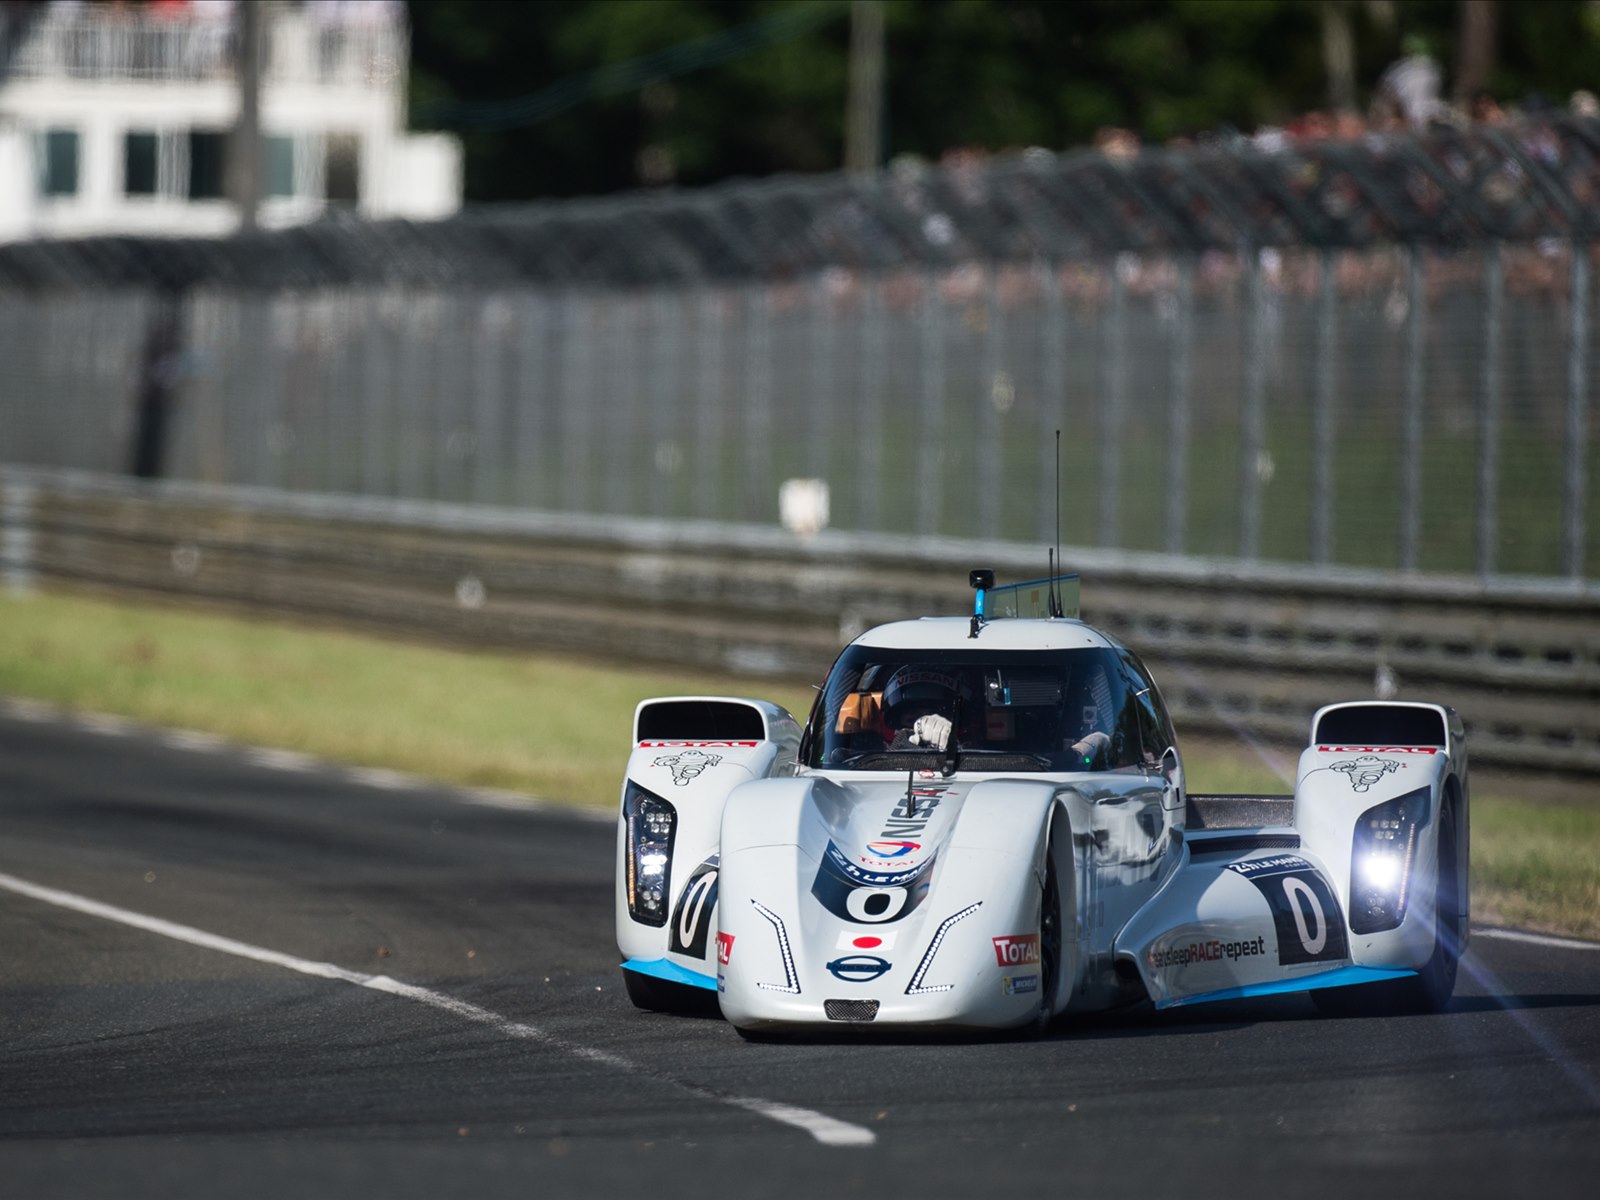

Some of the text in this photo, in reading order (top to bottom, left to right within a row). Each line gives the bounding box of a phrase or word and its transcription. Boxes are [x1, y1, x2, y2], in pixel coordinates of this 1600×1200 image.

[1322, 746, 1431, 754] TOTAL
[858, 855, 916, 866] TOTAL
[1282, 877, 1327, 955] 0
[995, 939, 1039, 962] TOTAL
